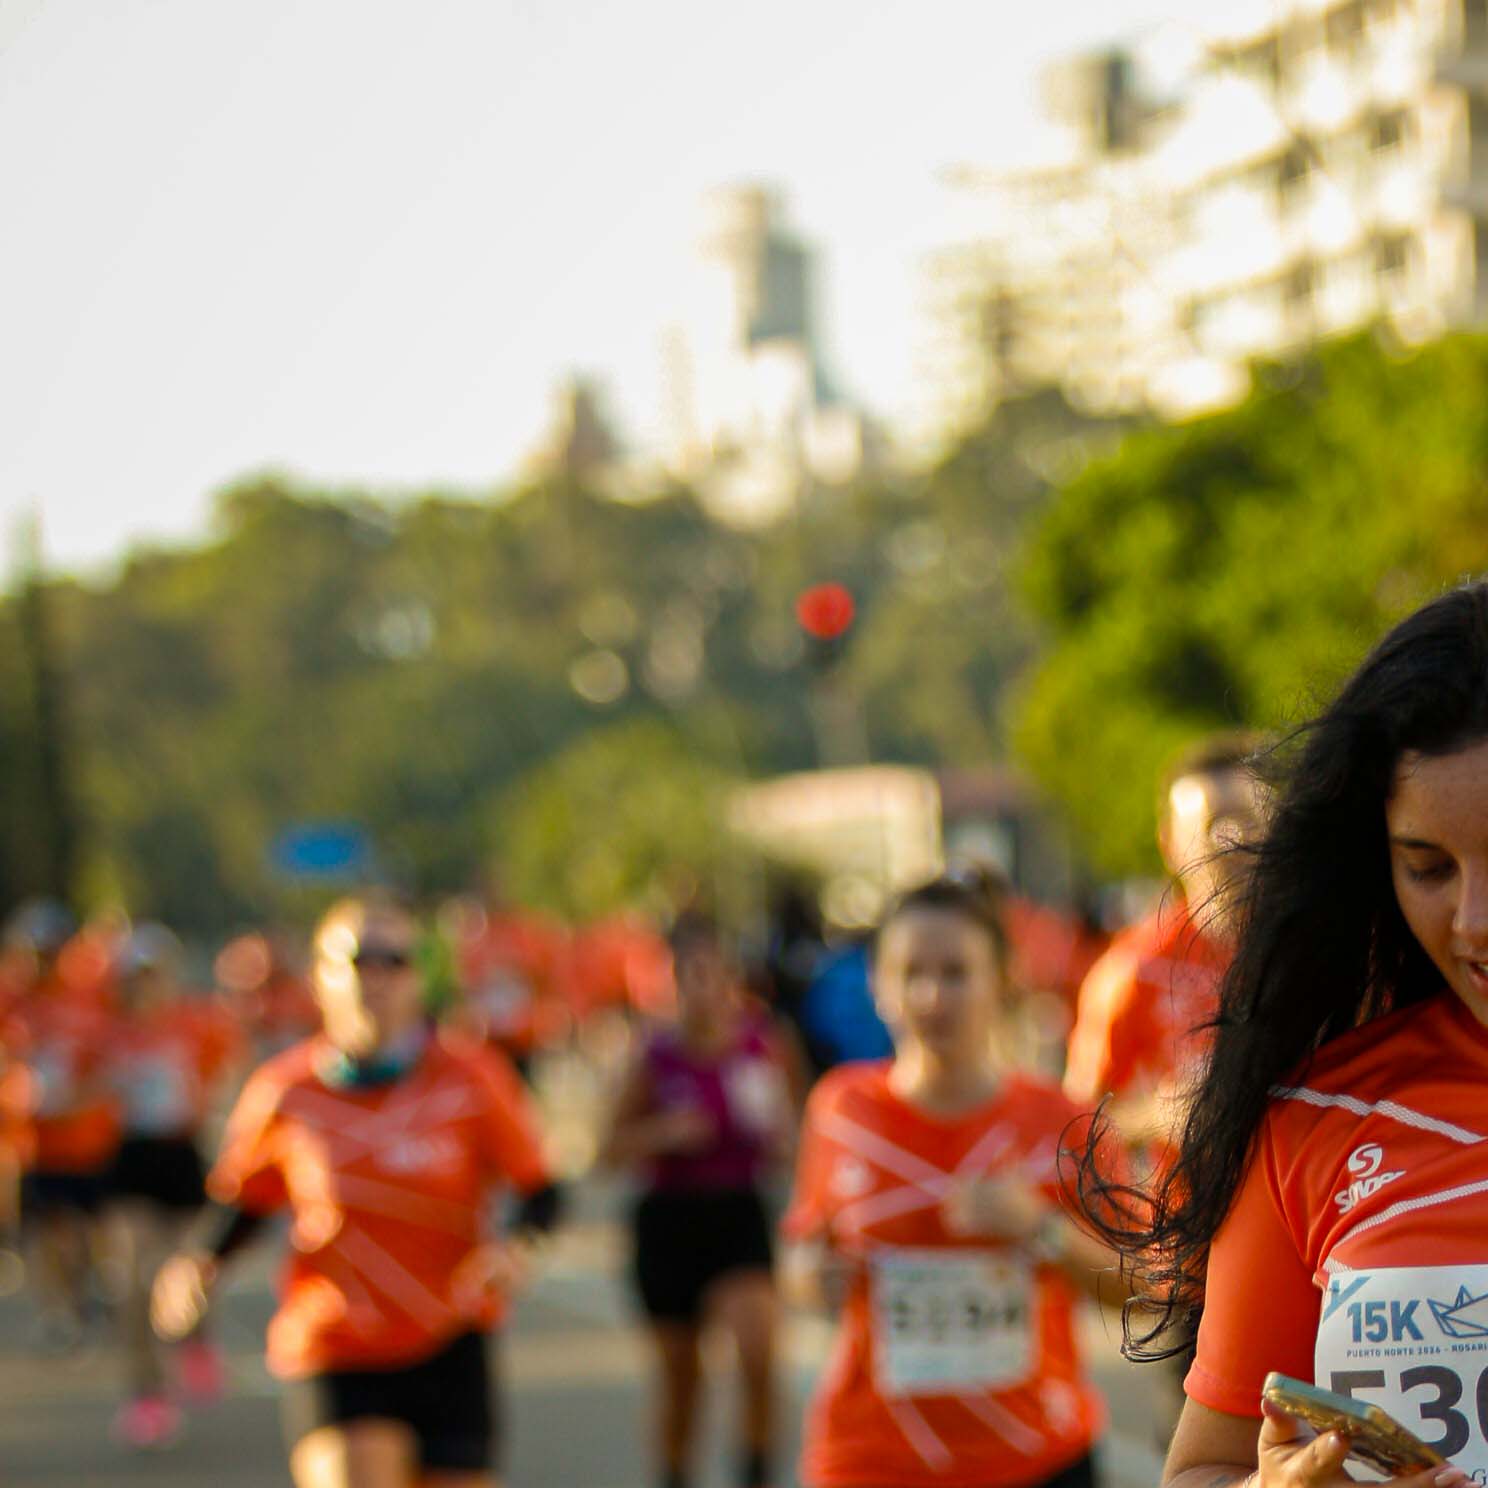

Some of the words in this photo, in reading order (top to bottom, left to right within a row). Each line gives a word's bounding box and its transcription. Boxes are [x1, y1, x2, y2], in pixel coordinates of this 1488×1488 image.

[1346, 1299, 1424, 1343] 15K
[1346, 1349, 1381, 1358] PUERTO
[1384, 1348, 1414, 1356] NORTE
